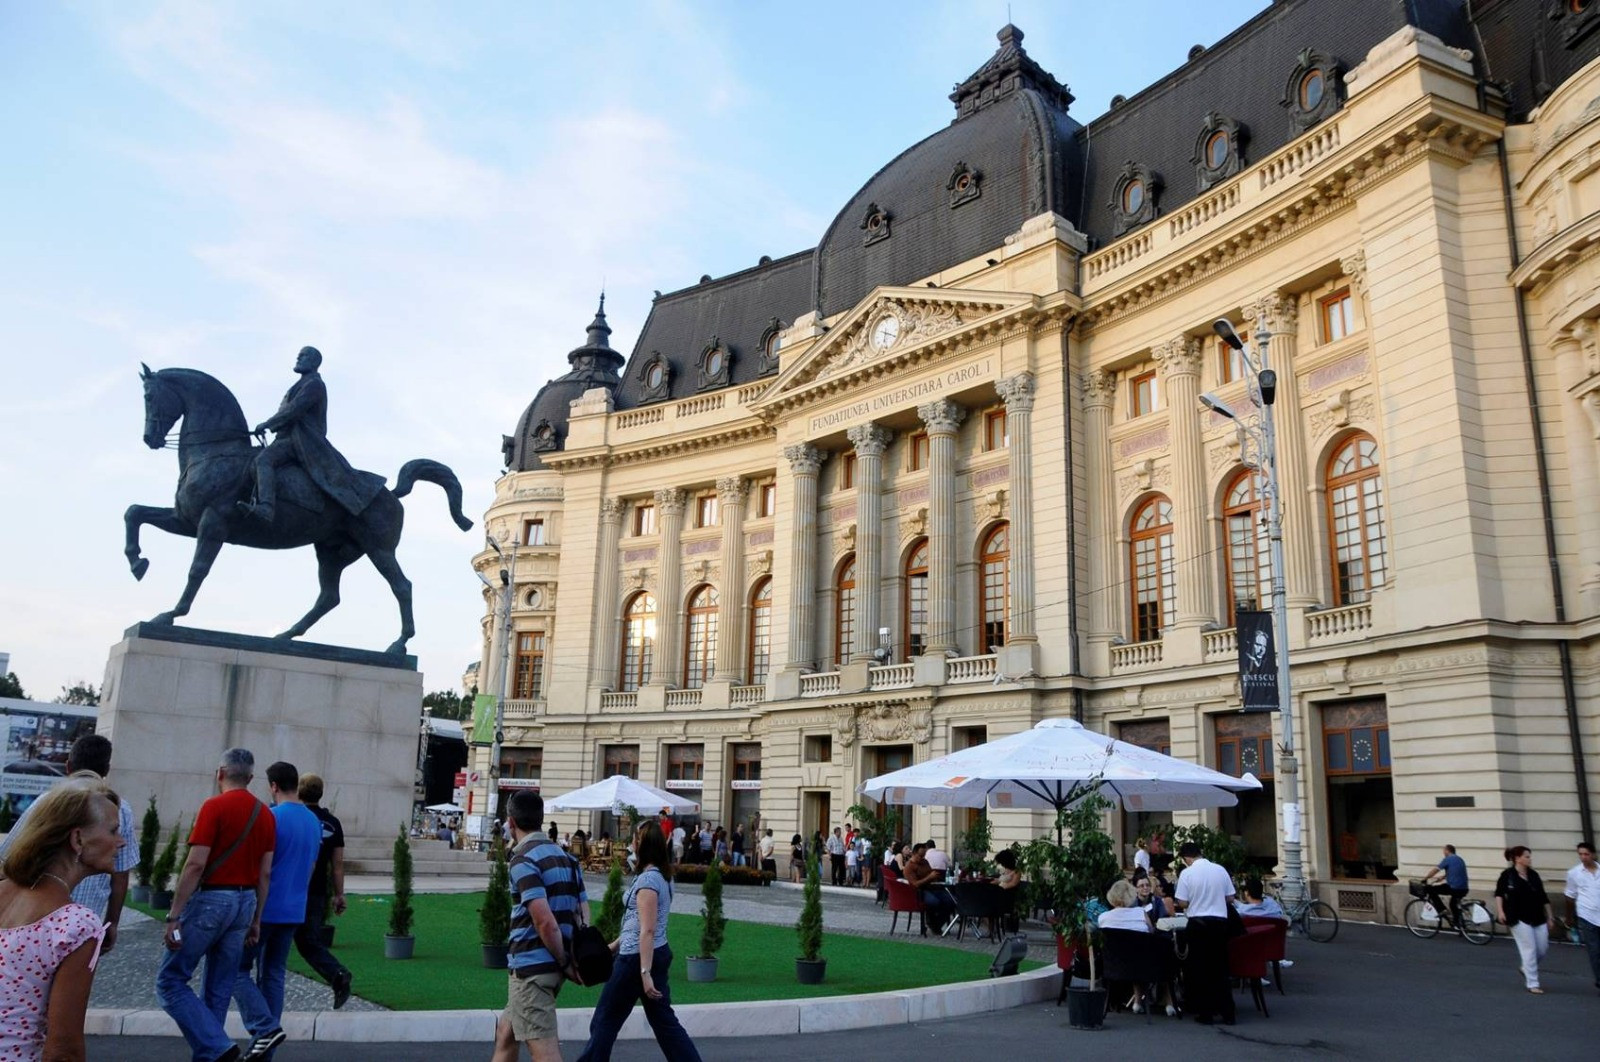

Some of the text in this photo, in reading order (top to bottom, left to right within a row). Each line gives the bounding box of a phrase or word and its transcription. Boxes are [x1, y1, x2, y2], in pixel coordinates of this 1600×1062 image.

[812, 360, 991, 431] FUNDATIUNEA UNIVERSITARA CAROL I
[1243, 673, 1275, 682] ENESCU
